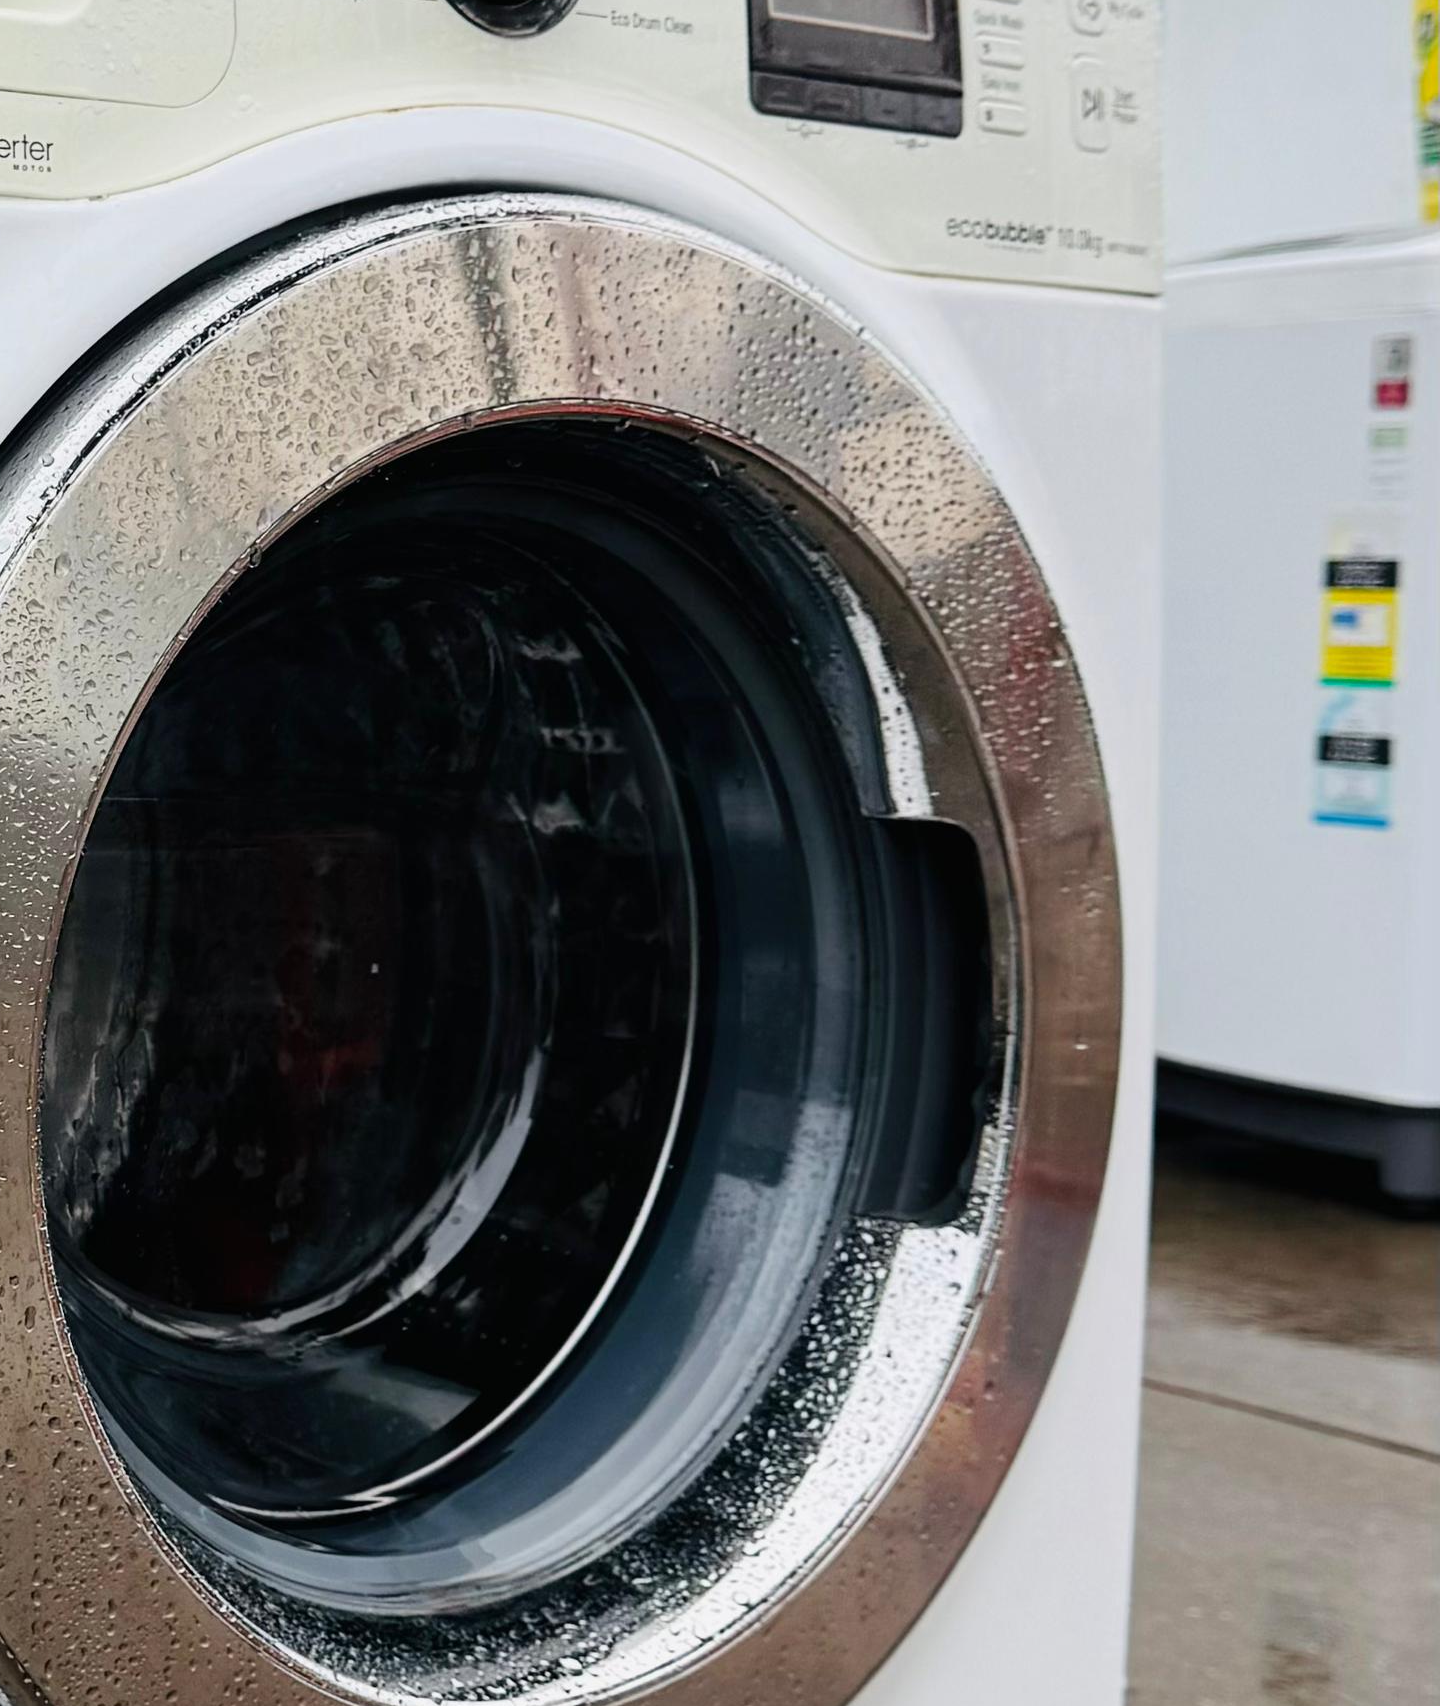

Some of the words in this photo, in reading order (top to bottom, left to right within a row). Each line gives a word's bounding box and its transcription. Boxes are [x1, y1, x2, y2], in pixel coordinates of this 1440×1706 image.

[611, 10, 630, 26] Eco
[632, 13, 660, 30] Drum
[664, 17, 693, 34] Clean
